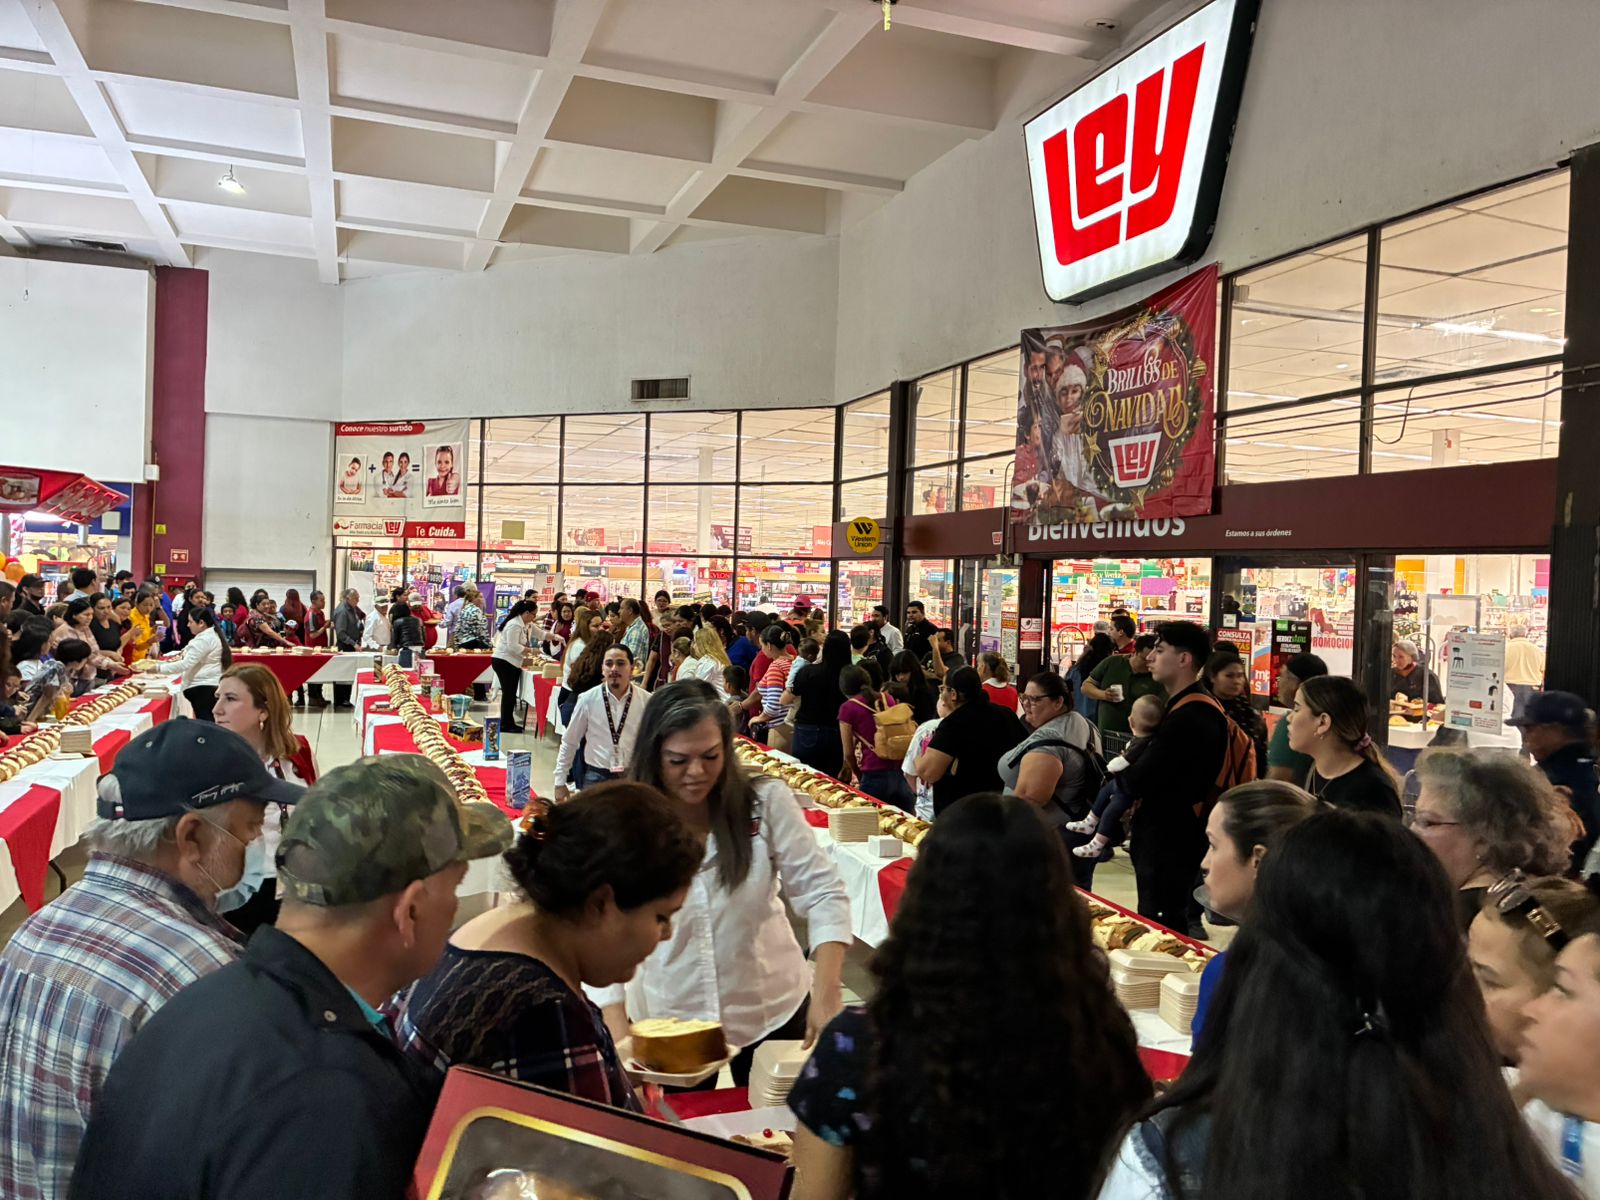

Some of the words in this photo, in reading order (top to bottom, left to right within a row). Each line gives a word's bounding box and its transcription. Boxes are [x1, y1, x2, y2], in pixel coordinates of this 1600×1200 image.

[1108, 348, 1161, 394] BRILLOS
[1162, 360, 1179, 380] DE
[1085, 384, 1189, 440] NAVIDAD
[340, 424, 364, 432] Conoce
[364, 424, 388, 432] nuestro
[389, 424, 413, 432] surtido
[350, 521, 383, 530] Farmacia
[416, 527, 425, 536] Te
[428, 526, 457, 537] Cuida.
[1225, 529, 1249, 537] Estamos
[1266, 528, 1292, 537] órdenes
[496, 585, 521, 593] Gillette
[1217, 631, 1250, 639] CONSULTA
[1312, 637, 1353, 649] ROMOCIO
